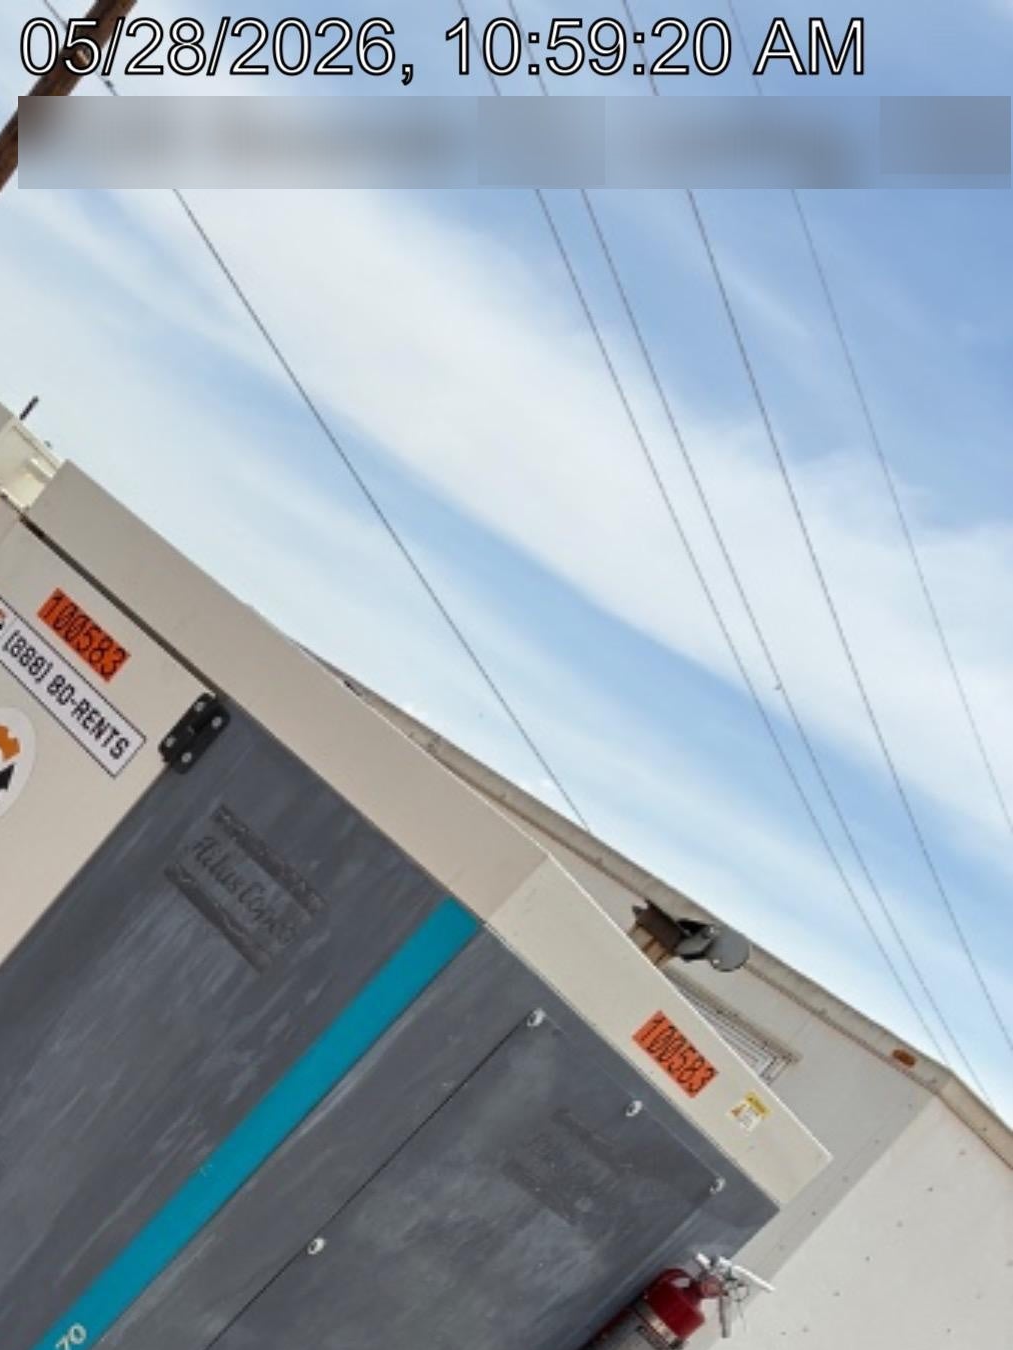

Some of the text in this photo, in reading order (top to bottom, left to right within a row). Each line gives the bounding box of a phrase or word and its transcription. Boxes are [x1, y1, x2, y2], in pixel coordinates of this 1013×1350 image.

[43, 594, 127, 679] 100583
[2, 629, 130, 760] (888) 80-RENTS
[639, 1017, 716, 1093] 100583
